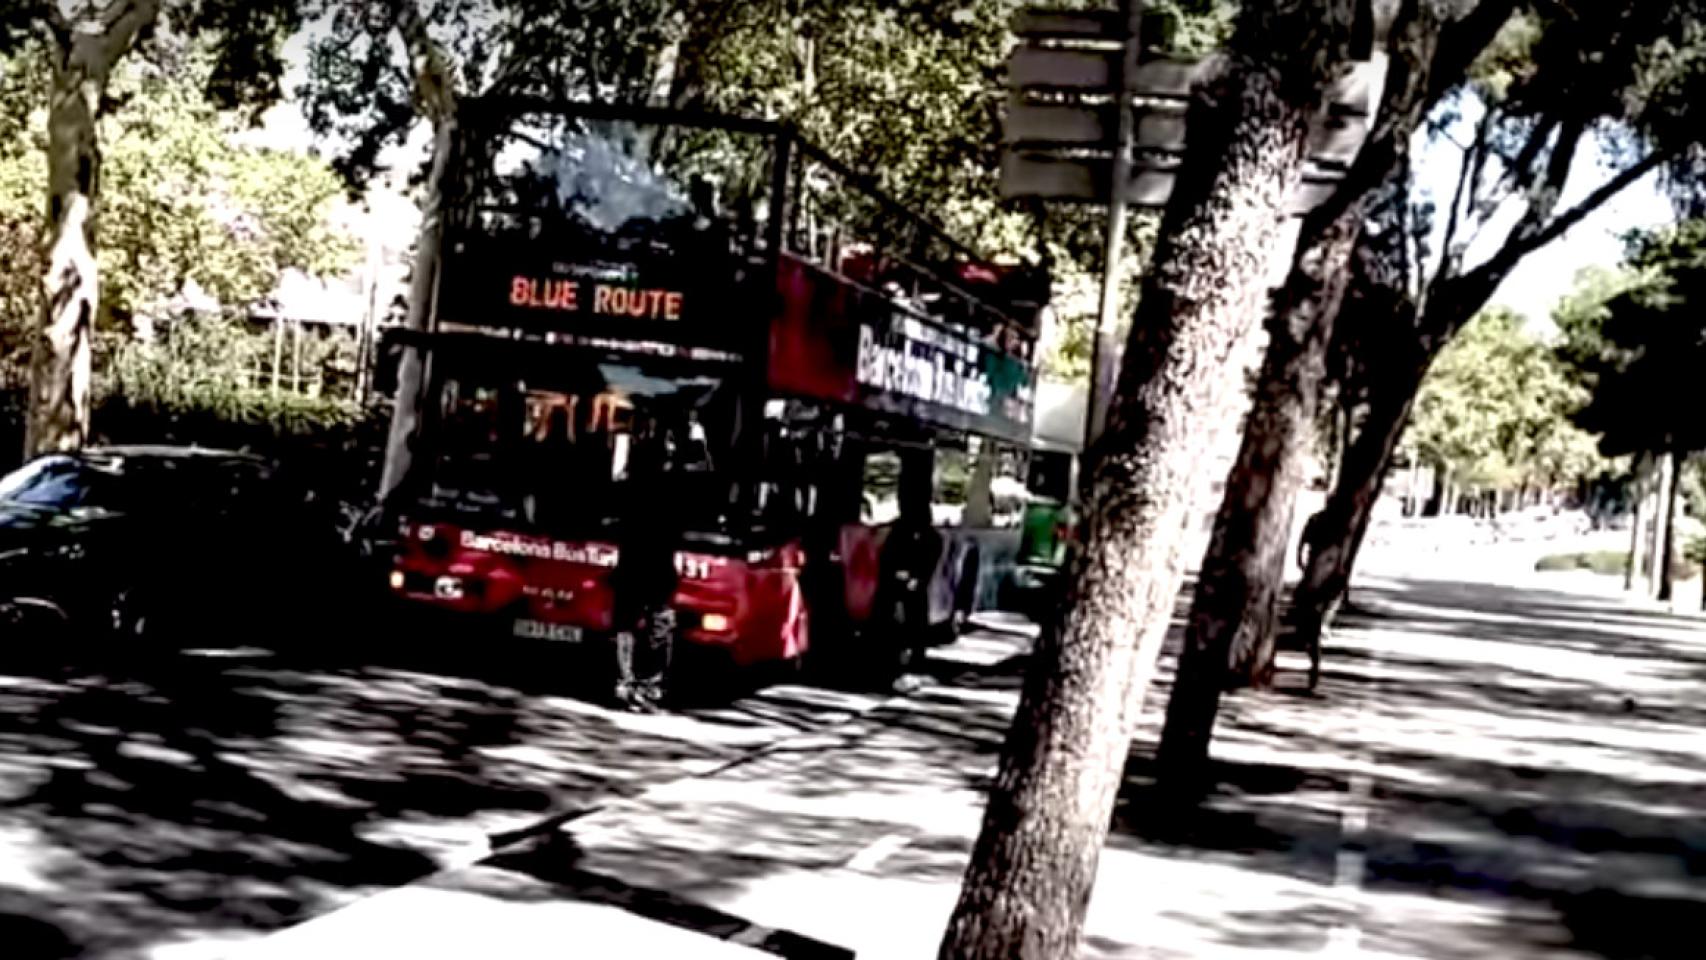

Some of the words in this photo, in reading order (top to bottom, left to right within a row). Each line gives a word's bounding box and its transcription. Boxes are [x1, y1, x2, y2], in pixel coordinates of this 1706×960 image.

[510, 275, 579, 311] BLUE
[593, 283, 684, 321] ROUTE
[460, 530, 551, 559] Barcelona
